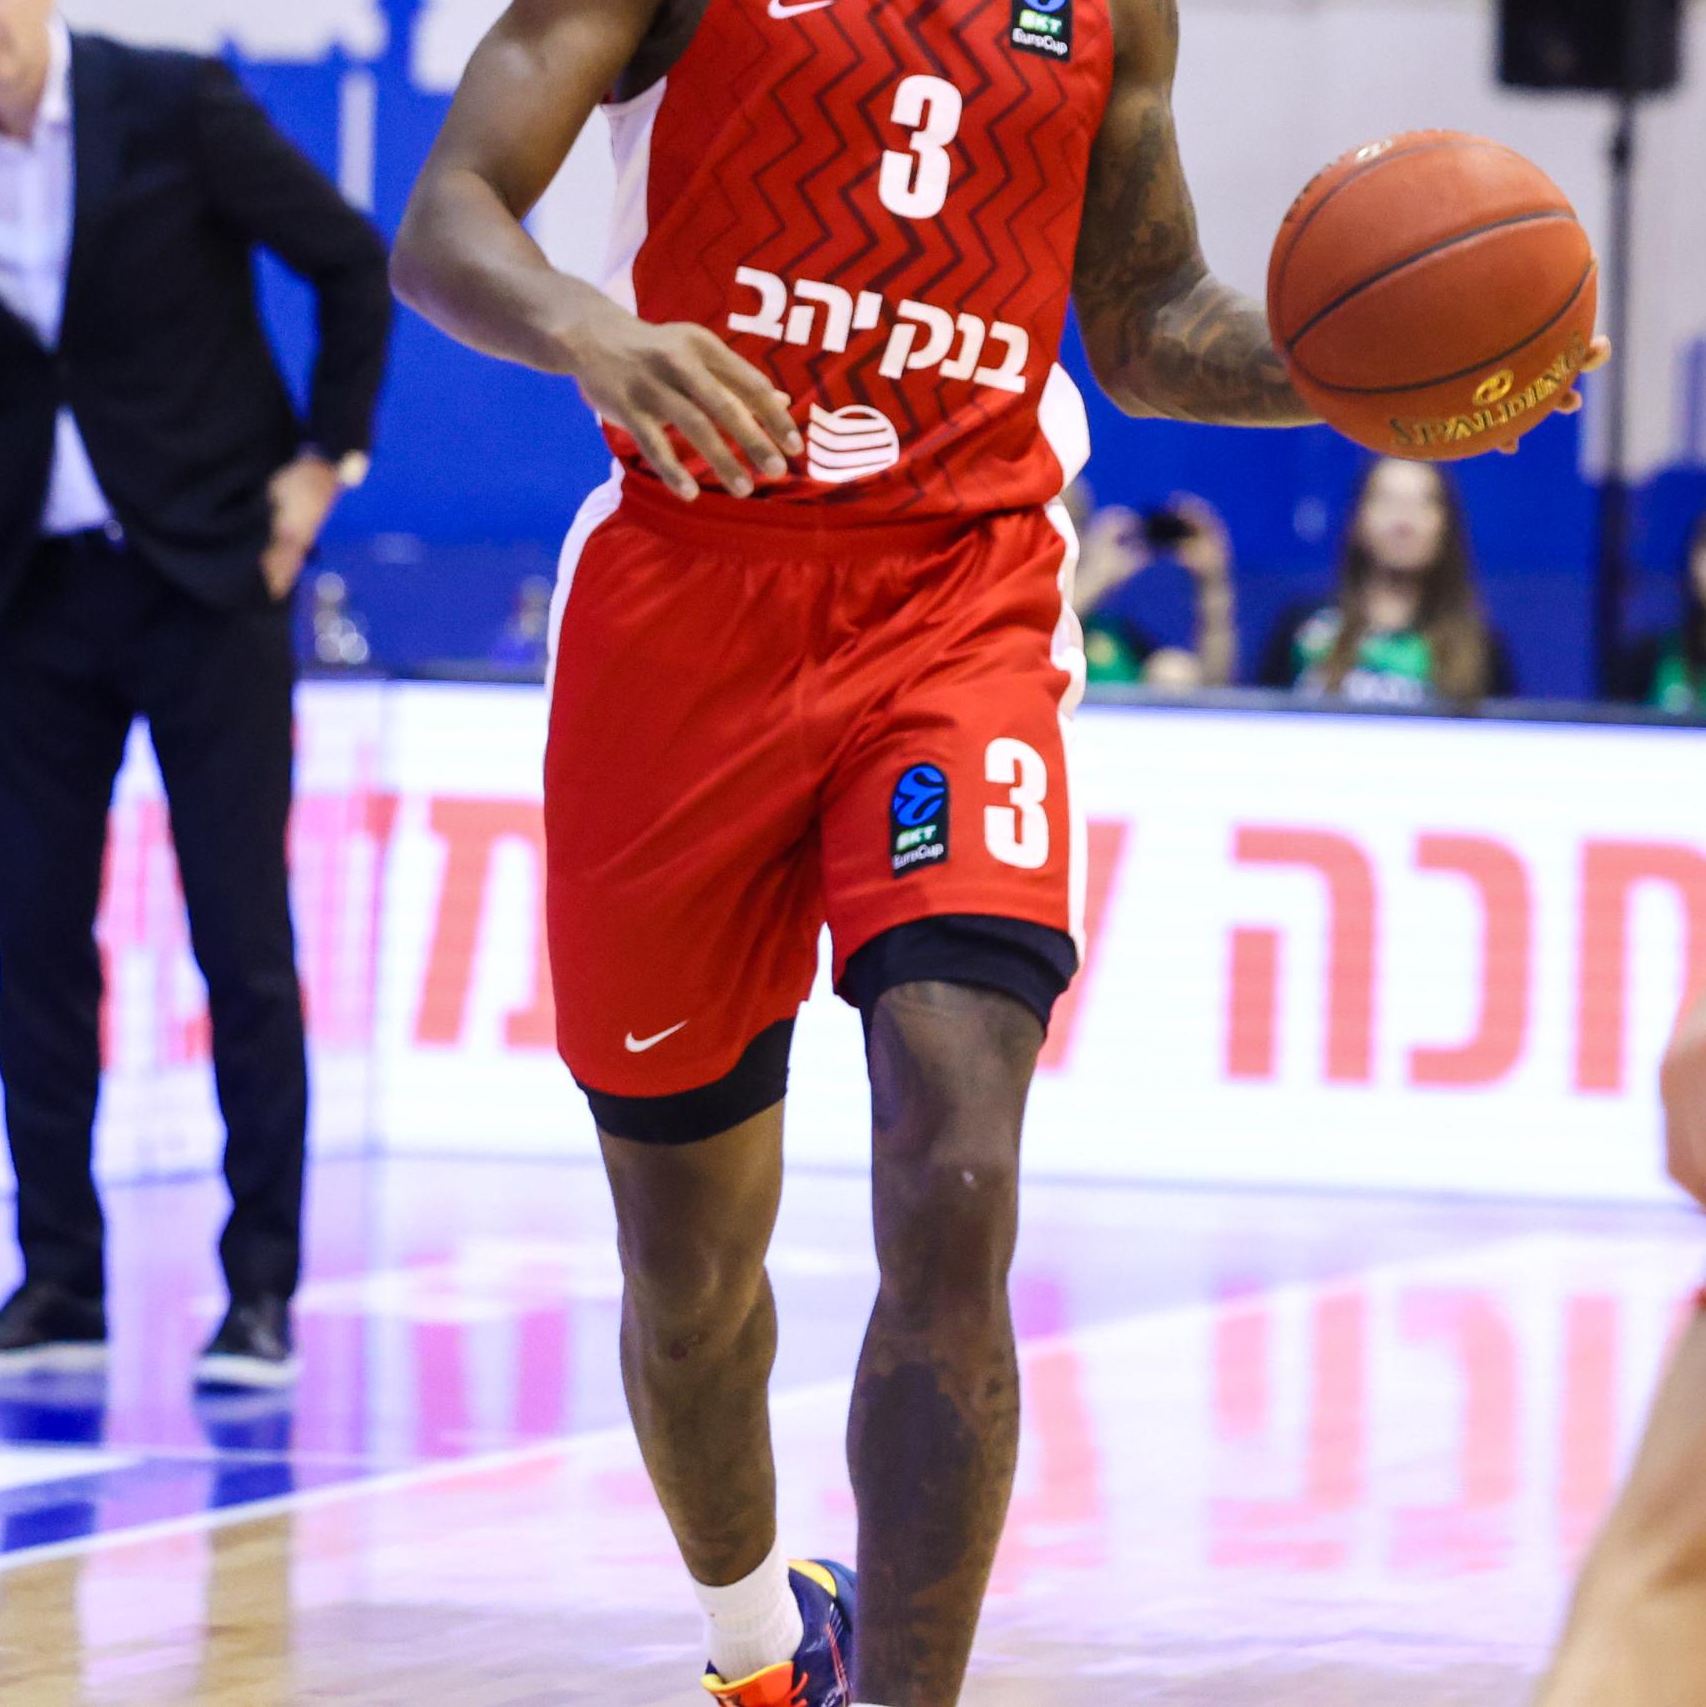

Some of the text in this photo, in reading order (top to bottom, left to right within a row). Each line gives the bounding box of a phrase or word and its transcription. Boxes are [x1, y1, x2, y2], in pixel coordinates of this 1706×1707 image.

[877, 74, 962, 218] 3
[727, 265, 1029, 393] בנק יהב
[984, 737, 1049, 869] 3
